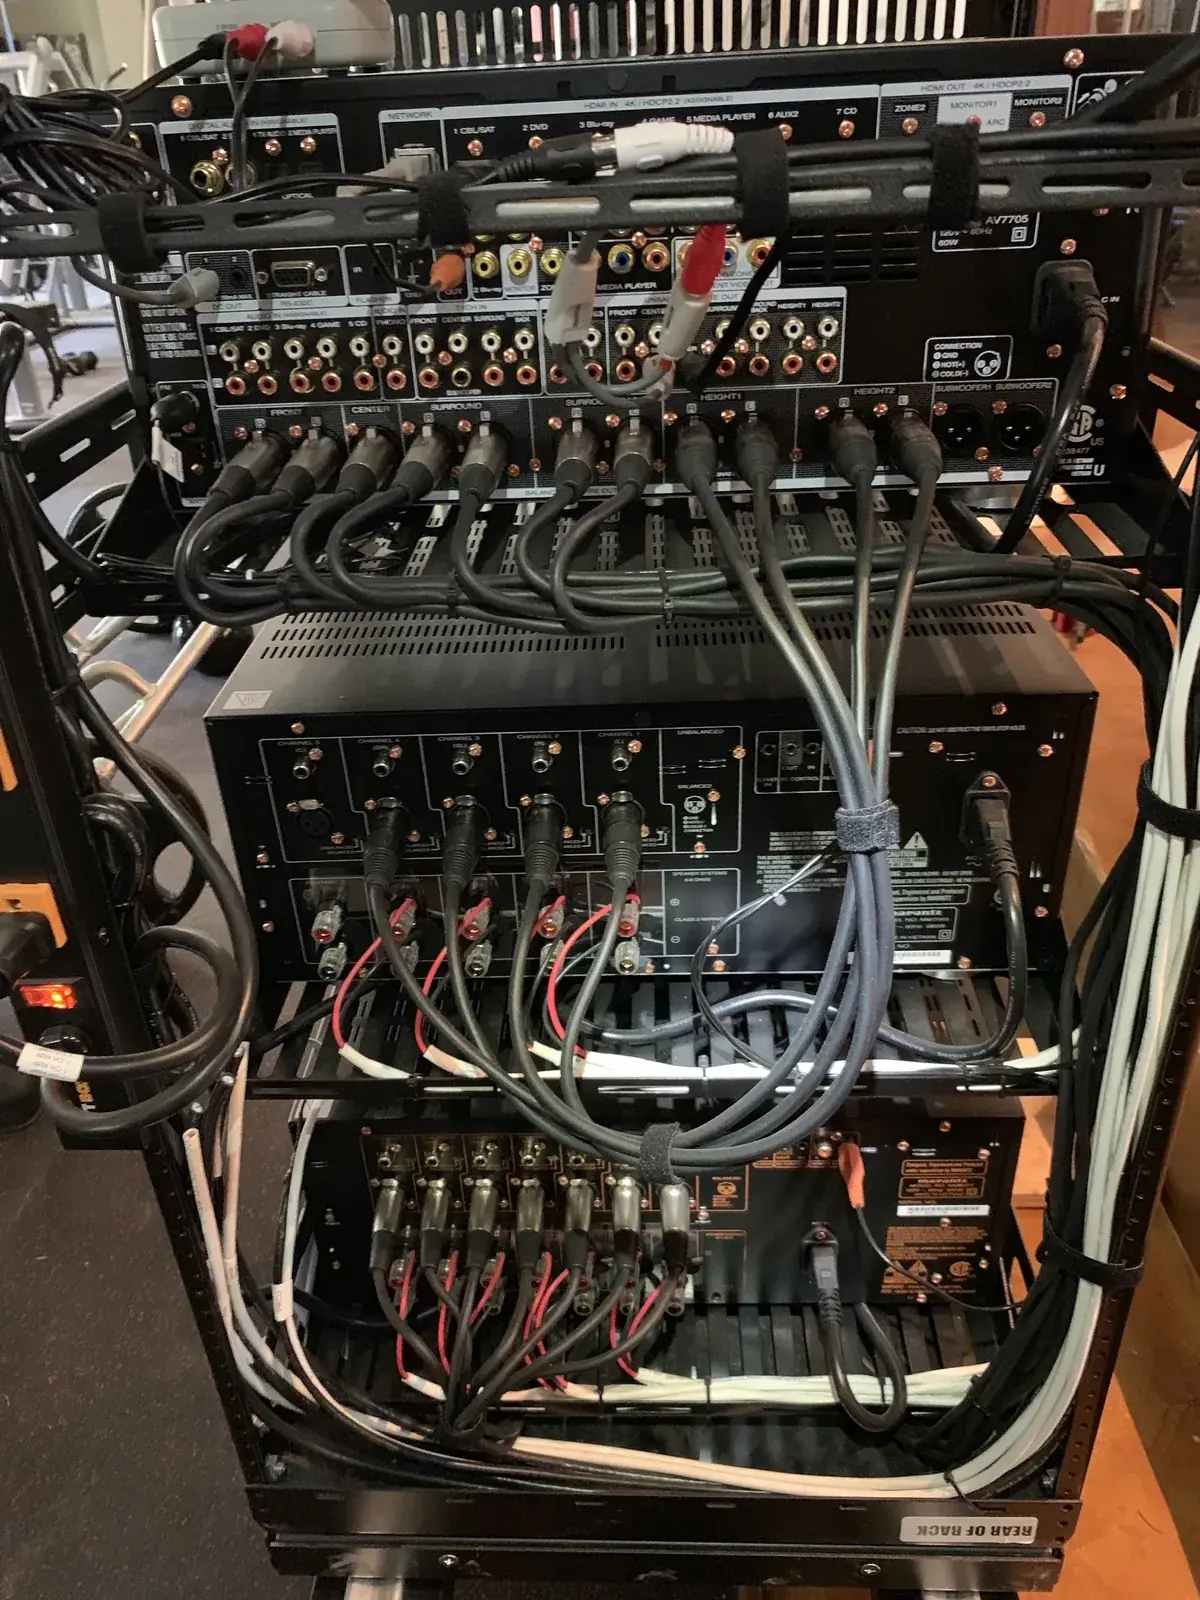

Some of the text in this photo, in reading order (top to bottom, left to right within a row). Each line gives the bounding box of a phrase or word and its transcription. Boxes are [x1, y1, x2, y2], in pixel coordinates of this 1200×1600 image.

[920, 84, 944, 92] HDMI
[946, 83, 966, 91] OUT
[950, 100, 998, 110] MONITOR1
[1014, 97, 1063, 106] MONITOR2
[843, 107, 858, 115] CD
[894, 104, 926, 112] ZONE2
[388, 111, 433, 120] NETWORK
[693, 114, 721, 122] MEDIA
[722, 112, 757, 122] PLAYER
[775, 110, 800, 118] AUX2
[460, 126, 496, 134] CBL/SAT
[522, 124, 529, 132] 2
[984, 214, 1030, 225] AV7705
[624, 282, 658, 290] PLAYER
[935, 384, 992, 392] SUBWOOFER1
[995, 382, 1054, 390] SUBWOOFER2
[854, 386, 896, 396] HEIGHT2
[700, 392, 742, 401] HEIGHT1
[350, 406, 390, 414] CENTER
[430, 402, 482, 411] SURROUND
[270, 408, 302, 416] FRONT
[676, 728, 725, 736] UNBALANCED
[916, 1525, 1033, 1536] REAR OF RACK
